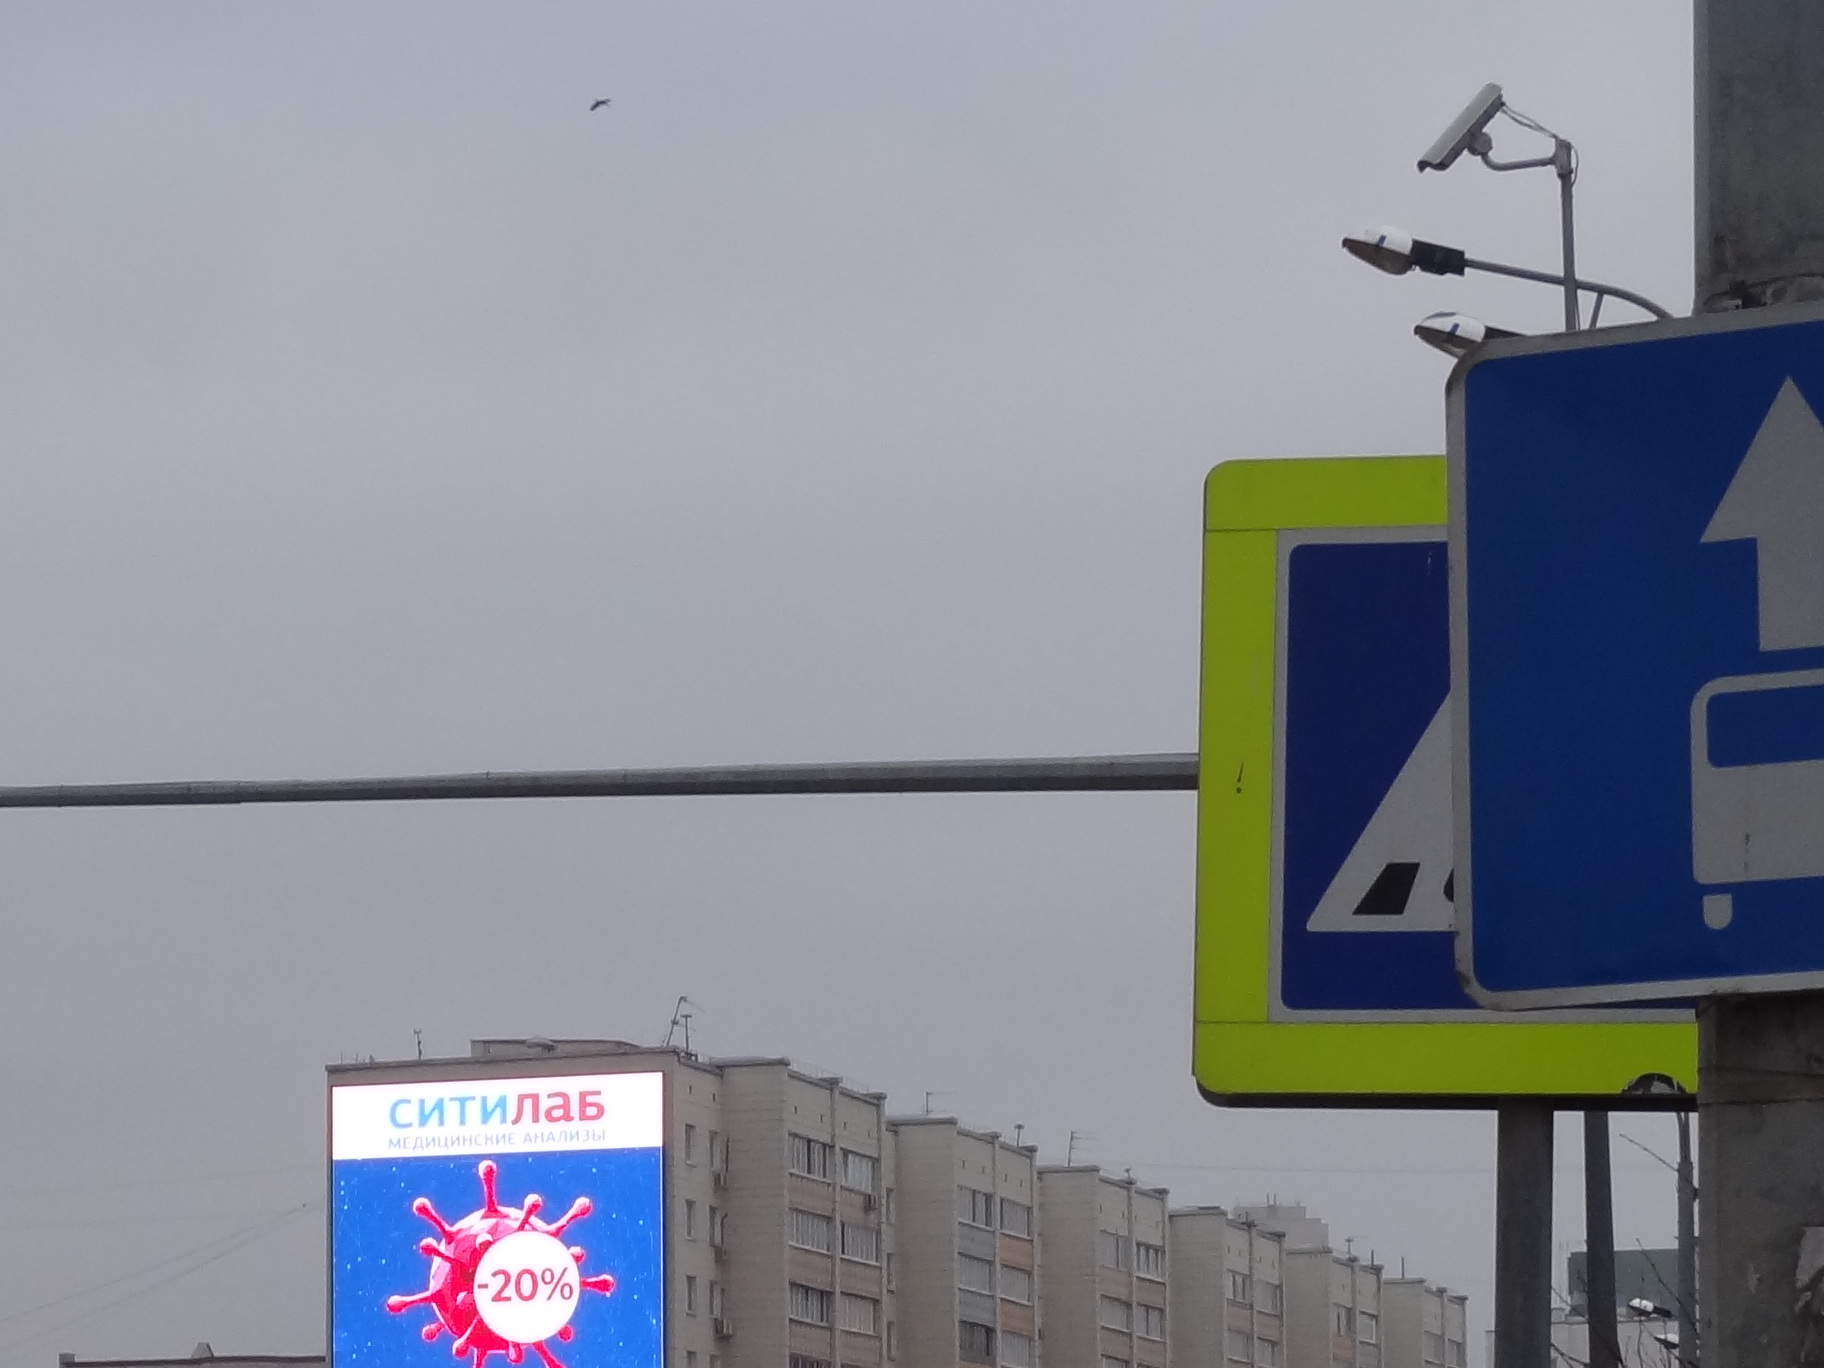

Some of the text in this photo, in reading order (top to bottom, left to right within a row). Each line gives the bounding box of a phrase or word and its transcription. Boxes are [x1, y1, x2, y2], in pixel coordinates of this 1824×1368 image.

[388, 1129, 606, 1151] МЕДИЦИНСКИЕ АНАЛИЗЫ
[477, 1266, 574, 1302] -20%
